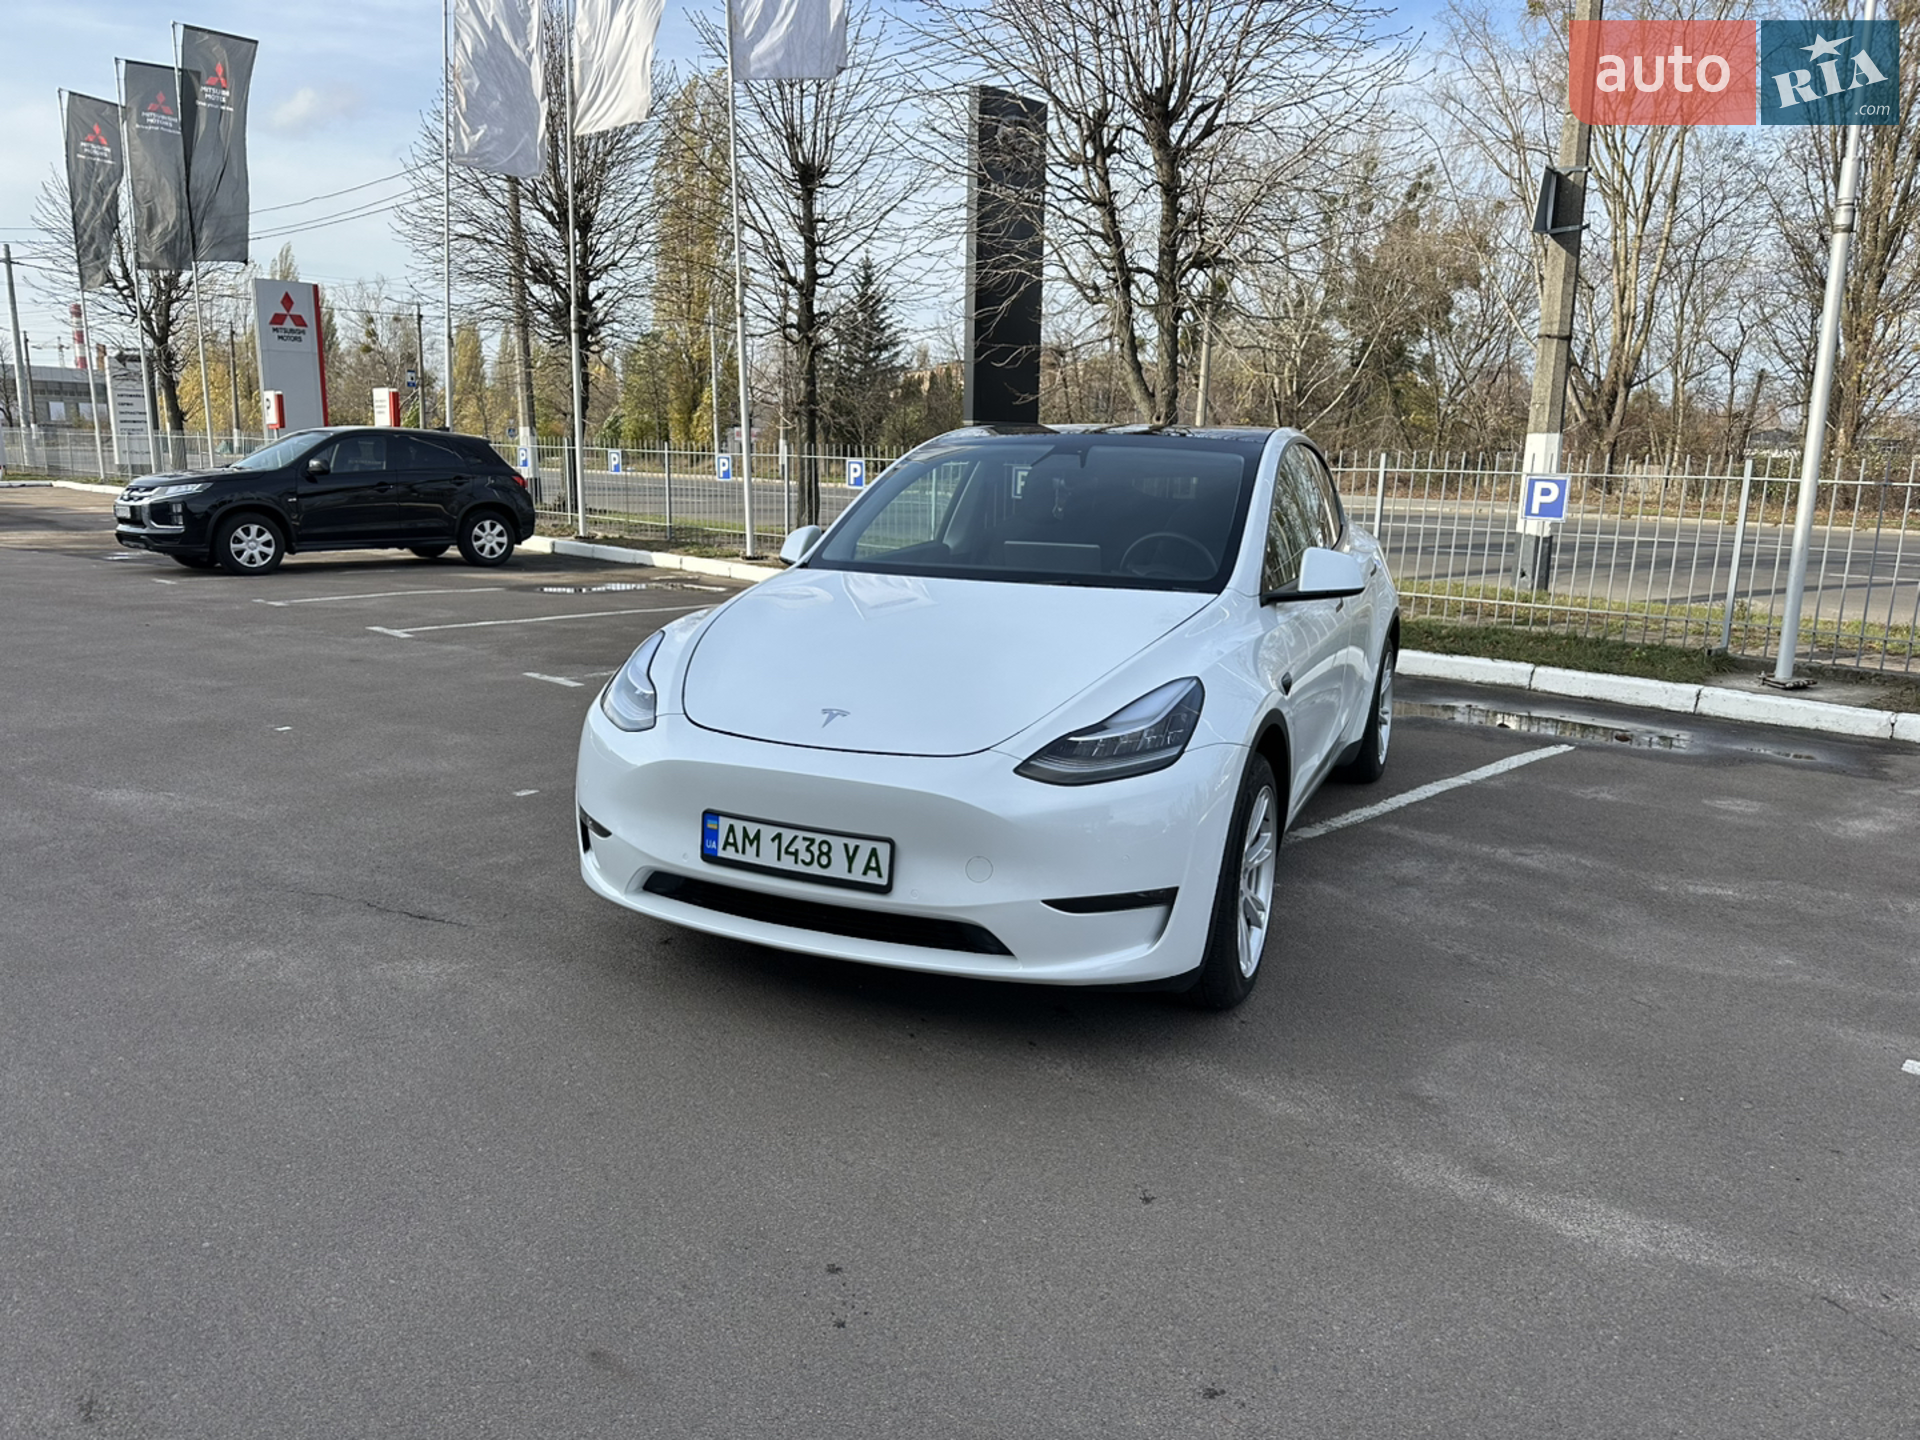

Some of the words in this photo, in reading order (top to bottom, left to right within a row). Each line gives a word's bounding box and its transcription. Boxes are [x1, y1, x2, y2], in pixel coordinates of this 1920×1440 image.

[146, 118, 173, 128] MOTORS
[272, 327, 306, 336] MITSUBISHI
[277, 335, 303, 343] MOTORS
[519, 448, 527, 467] P
[610, 453, 619, 472] P
[719, 458, 729, 478] P
[850, 463, 862, 485] P
[1531, 481, 1560, 515] P
[706, 839, 718, 849] UA
[722, 823, 761, 858] AM
[770, 832, 833, 869] 1438
[843, 842, 884, 879] YA
